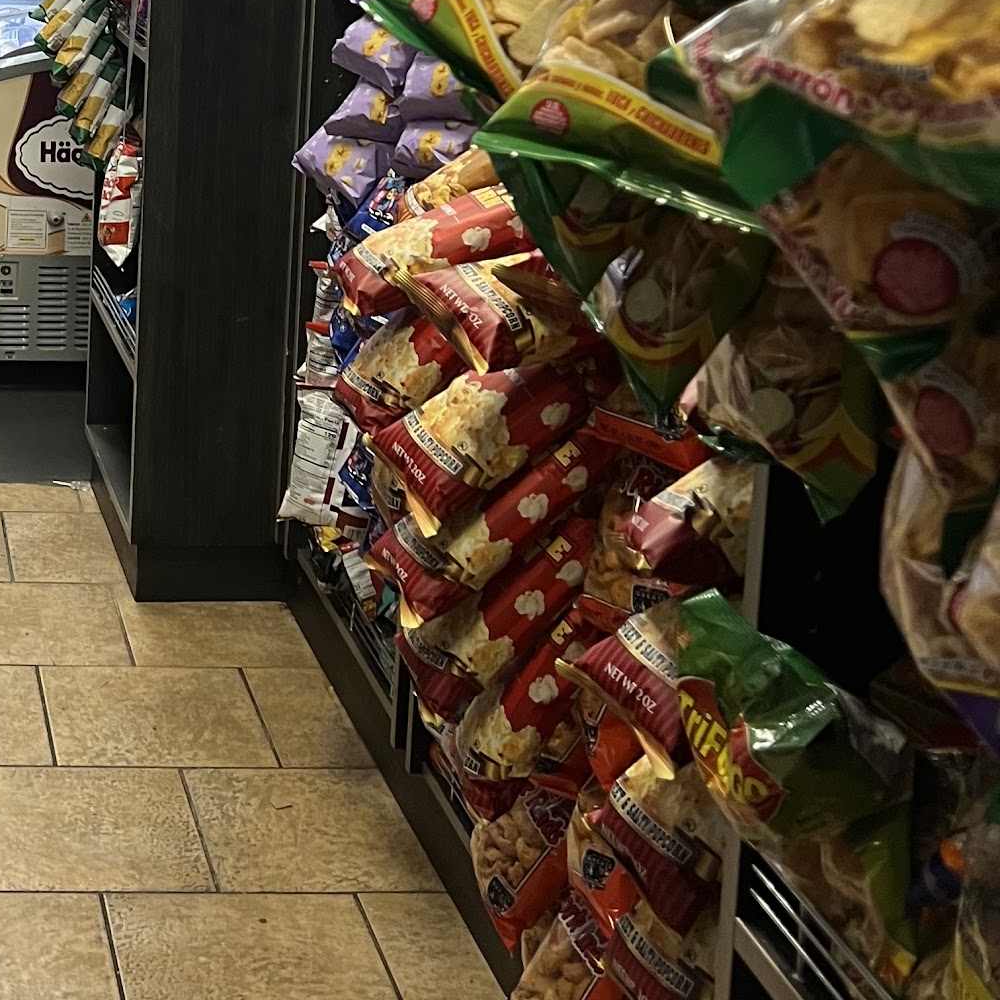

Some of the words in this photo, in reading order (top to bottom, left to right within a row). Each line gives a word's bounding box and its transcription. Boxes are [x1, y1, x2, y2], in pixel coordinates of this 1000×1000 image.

[493, 297, 522, 331] POPCORN
[432, 446, 463, 475] POPCORN
[604, 662, 624, 681] NET
[621, 676, 638, 694] WT
[641, 695, 657, 715] OZ
[626, 803, 650, 833] SALTY
[649, 825, 693, 864] POPCORN
[652, 956, 693, 996] POPCORN
